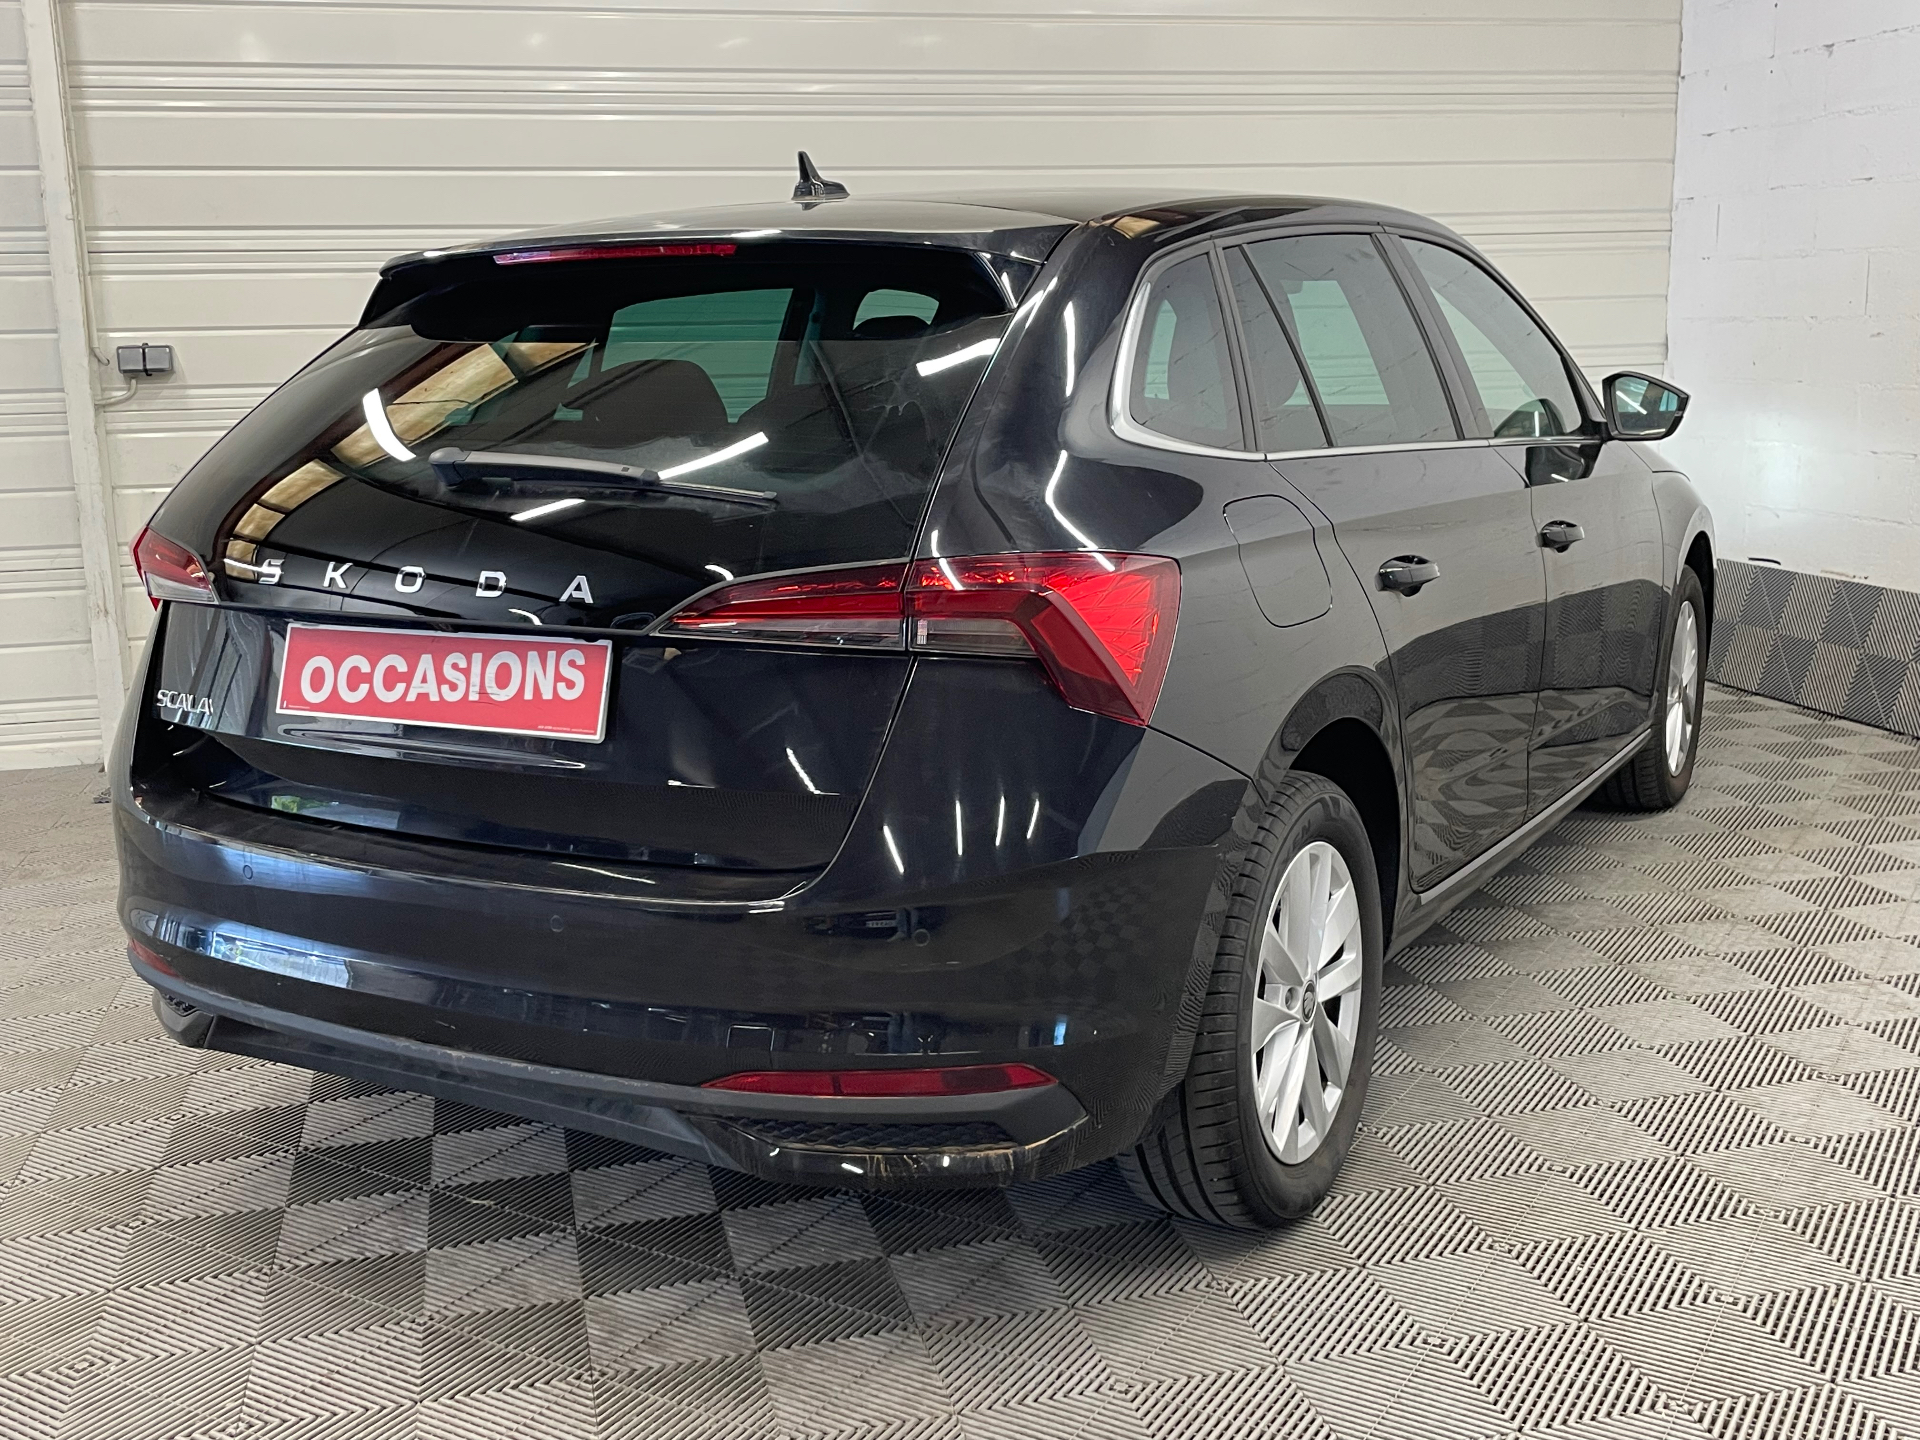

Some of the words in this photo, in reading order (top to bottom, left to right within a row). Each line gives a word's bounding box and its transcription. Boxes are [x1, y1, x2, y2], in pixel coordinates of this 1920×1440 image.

[258, 558, 594, 604] SKODA
[300, 649, 586, 704] OCCASIONS
[156, 689, 211, 715] SCALA
